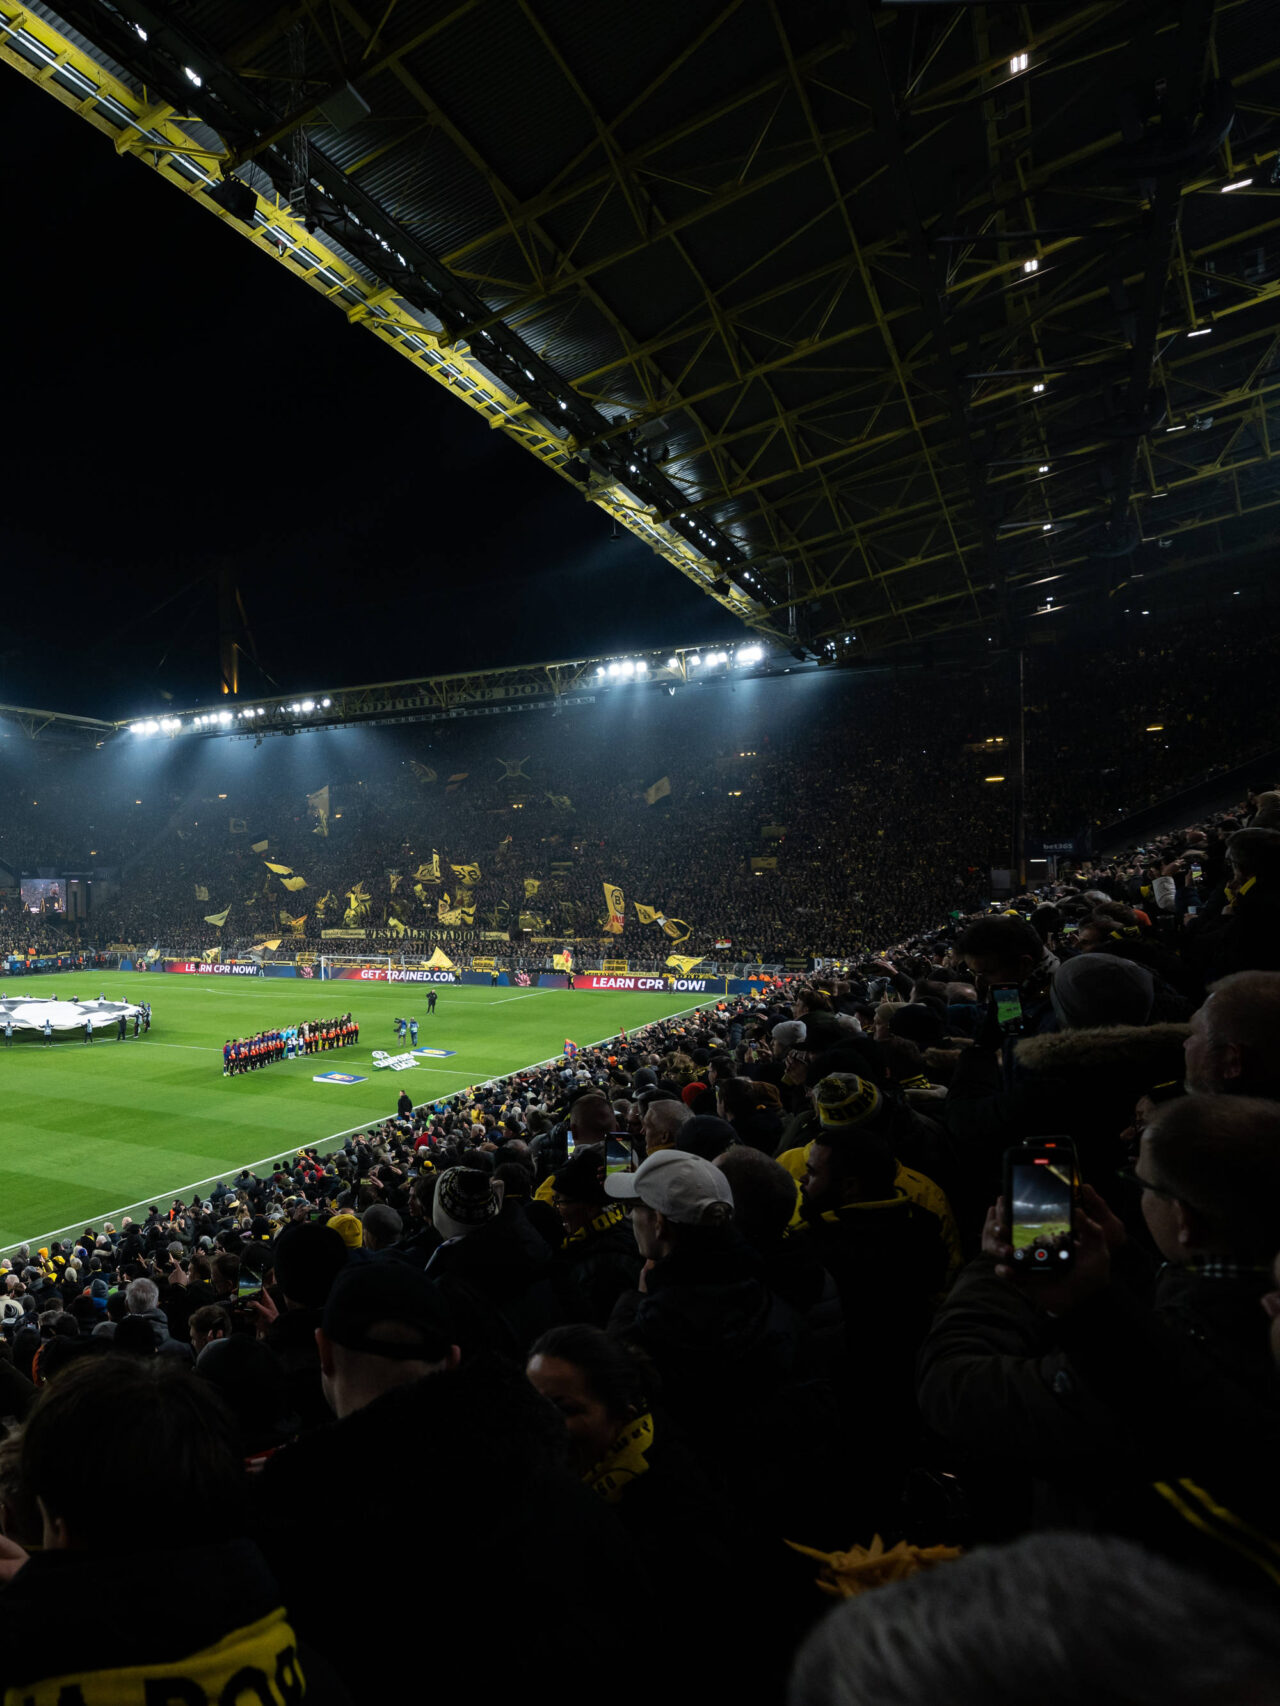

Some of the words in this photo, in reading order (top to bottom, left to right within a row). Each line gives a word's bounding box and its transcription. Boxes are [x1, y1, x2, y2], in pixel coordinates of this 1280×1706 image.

[185, 963, 212, 973] LERN
[213, 964, 231, 974] CPR
[232, 965, 257, 975] NOW!
[592, 977, 635, 989] LEARN
[637, 978, 664, 990] CPR
